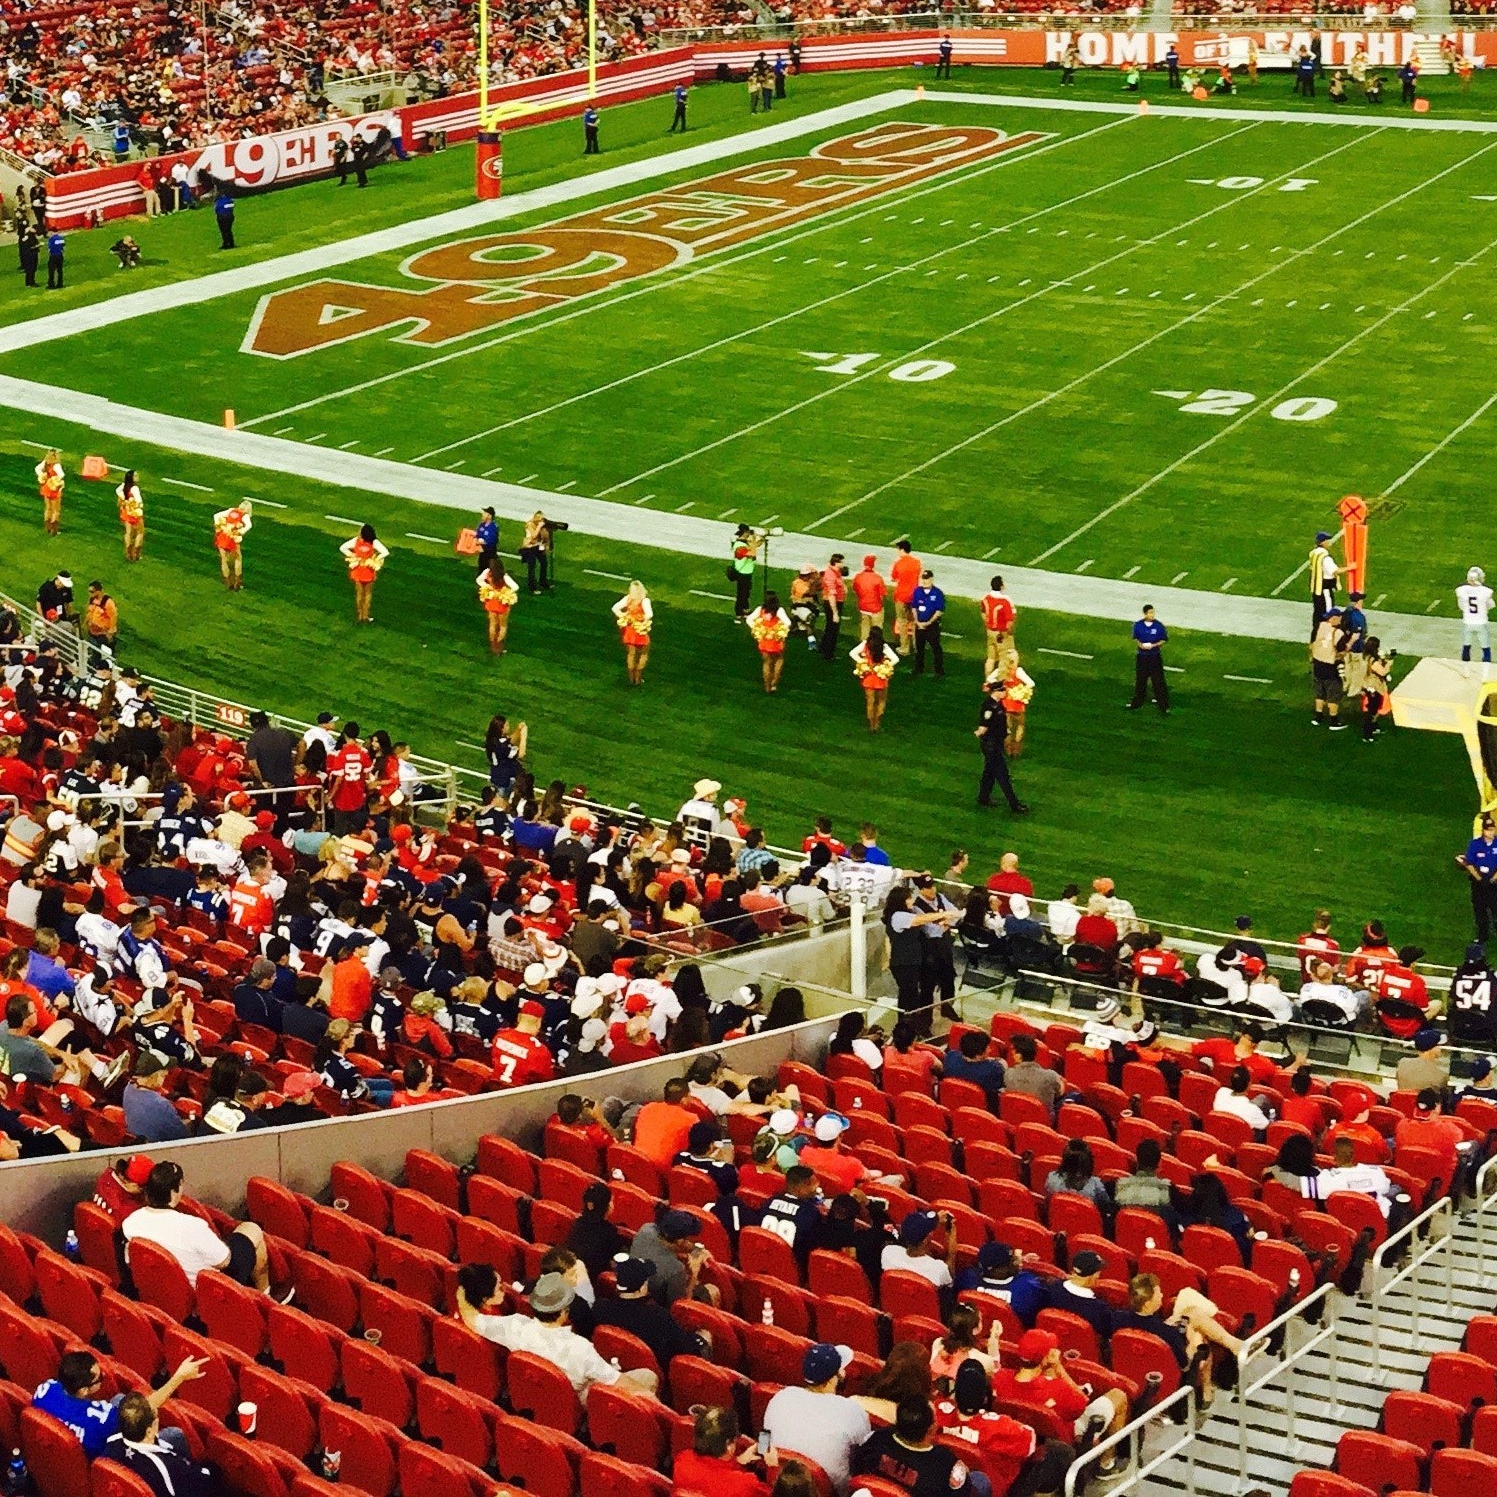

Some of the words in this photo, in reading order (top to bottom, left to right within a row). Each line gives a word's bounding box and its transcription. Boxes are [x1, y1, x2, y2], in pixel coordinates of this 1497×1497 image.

[239, 121, 1060, 361] 49ERS
[812, 351, 957, 384] 10
[1180, 388, 1340, 423] 20
[1468, 596, 1478, 614] 5
[220, 704, 244, 724] 119
[1456, 980, 1491, 1011] 54
[499, 1055, 516, 1083] 7
